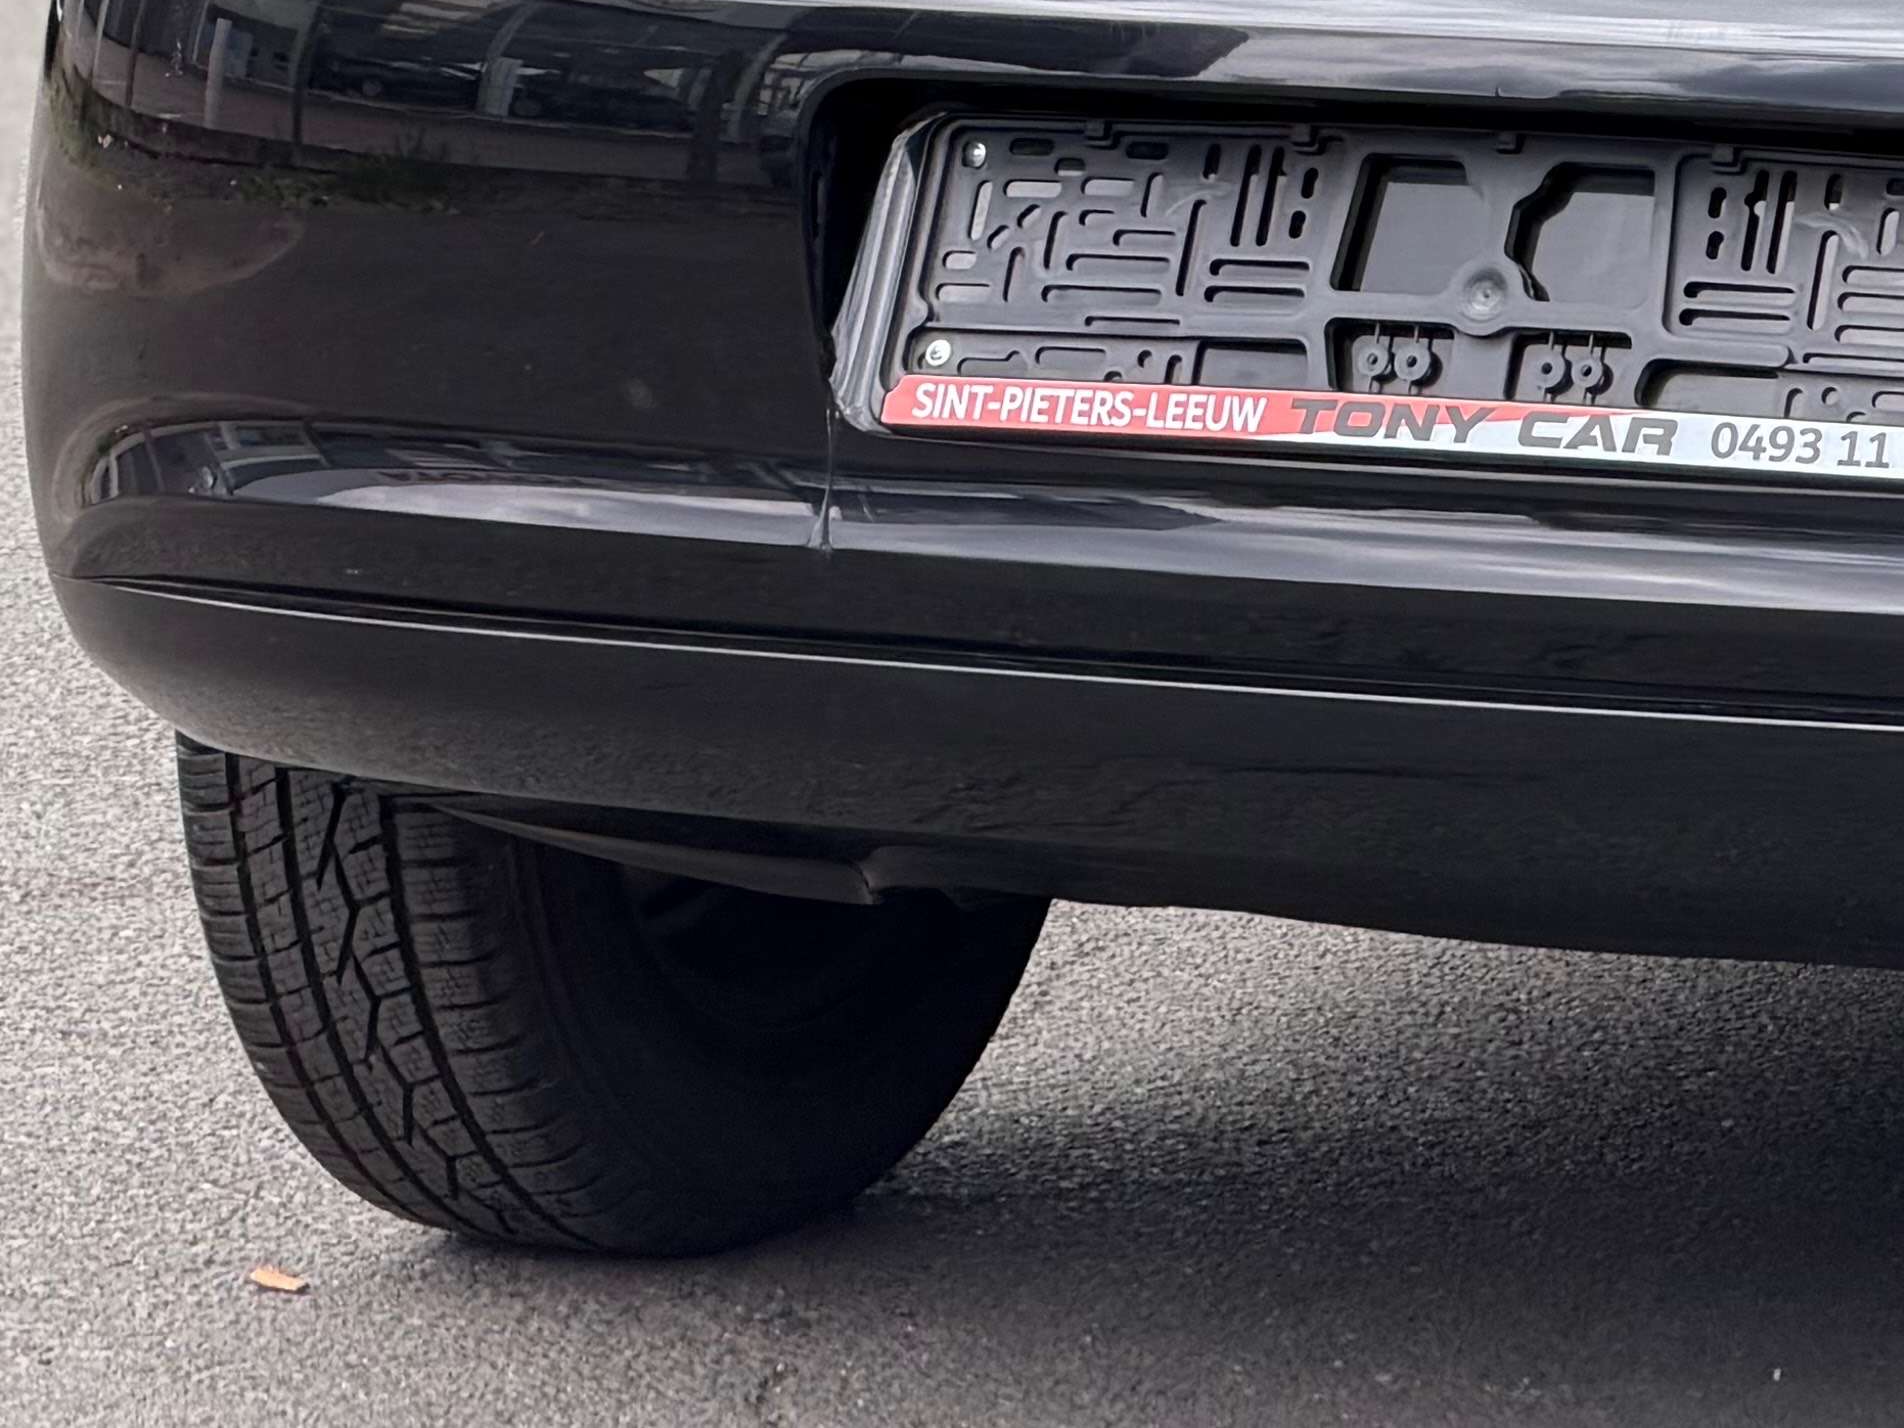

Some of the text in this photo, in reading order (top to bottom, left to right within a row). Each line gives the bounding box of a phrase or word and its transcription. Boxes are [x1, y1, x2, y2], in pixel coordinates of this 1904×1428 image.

[911, 382, 1268, 433] SINT-PIETERS-LEEUW
[1290, 398, 1496, 445] TONY
[1518, 411, 1679, 457] CAR
[1711, 421, 1822, 465] 0493
[1837, 431, 1890, 469] 11
